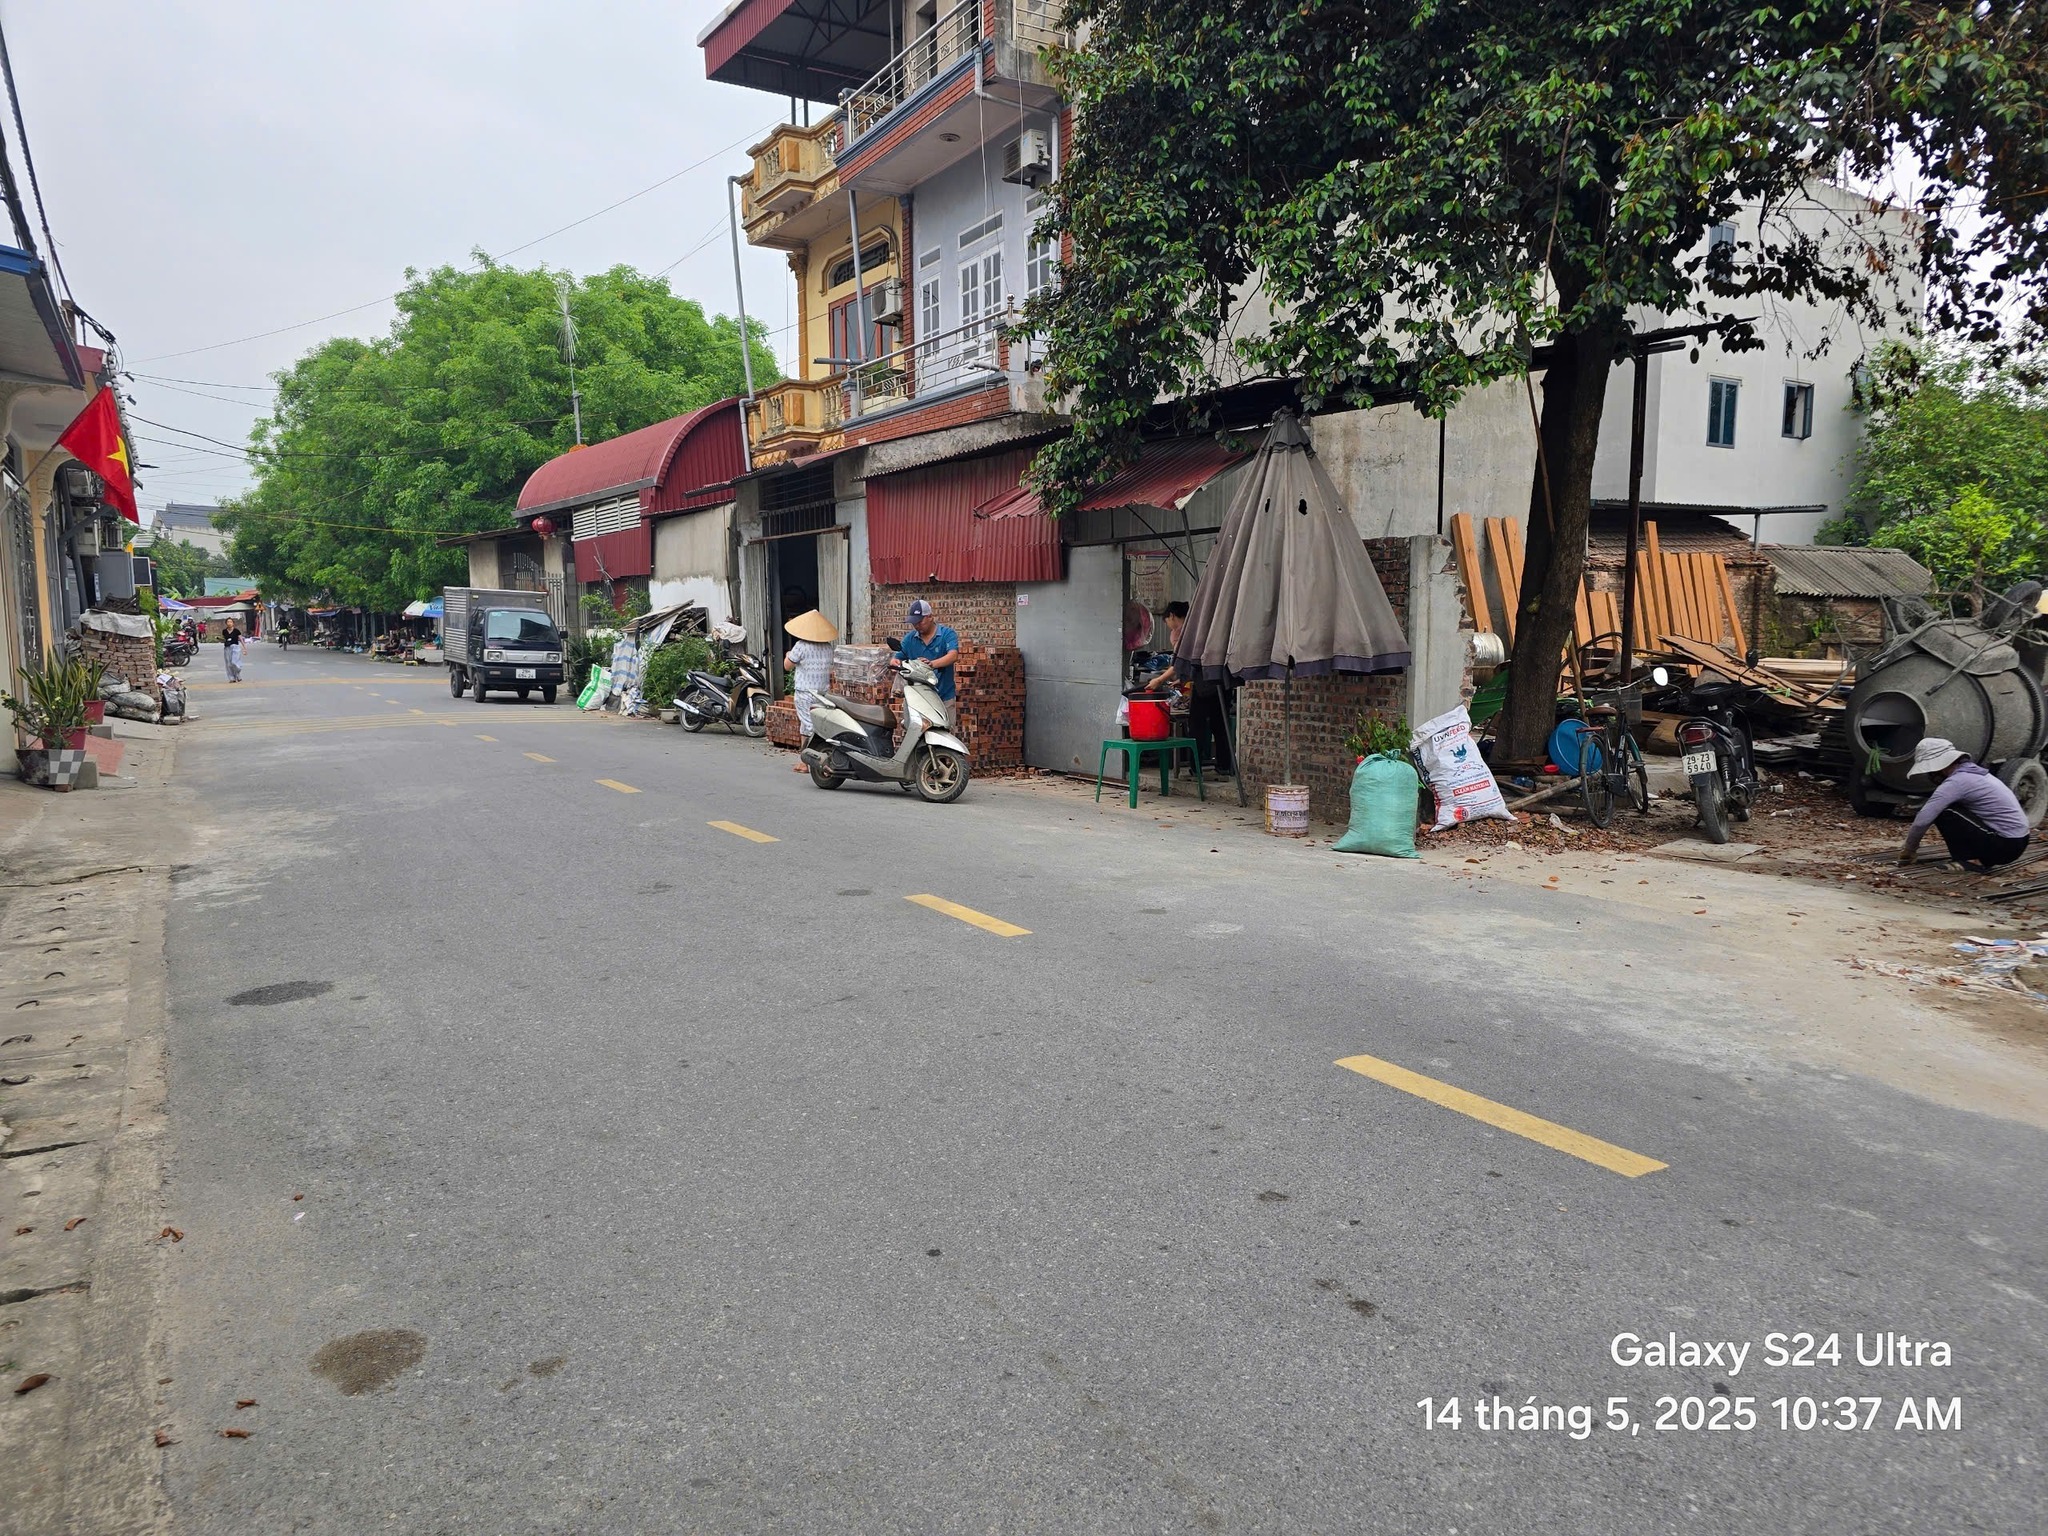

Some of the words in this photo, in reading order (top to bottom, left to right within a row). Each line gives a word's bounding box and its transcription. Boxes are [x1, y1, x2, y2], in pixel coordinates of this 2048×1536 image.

[1433, 725, 1466, 742] UVNFEED
[1686, 753, 1710, 765] 29-Z3
[1687, 762, 1711, 773] 5940
